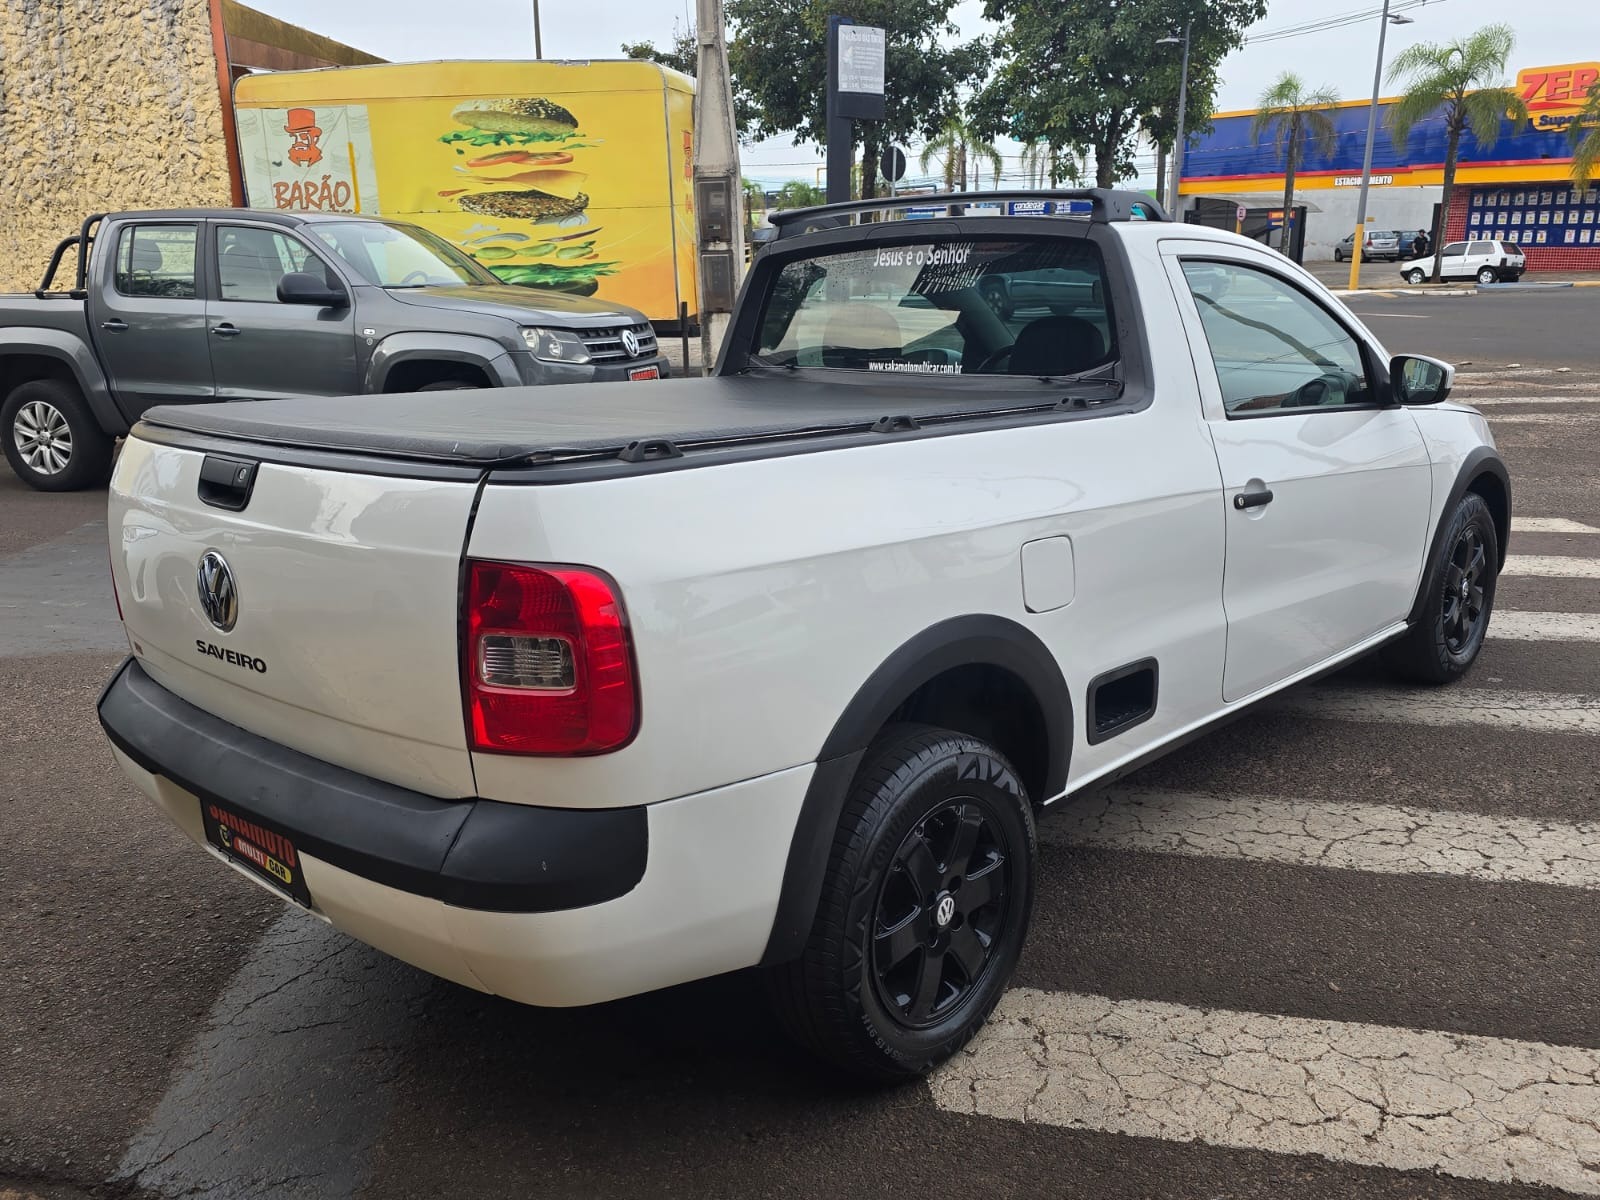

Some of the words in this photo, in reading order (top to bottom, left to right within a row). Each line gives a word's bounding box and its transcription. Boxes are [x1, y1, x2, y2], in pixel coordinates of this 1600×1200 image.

[273, 174, 351, 210] BARÃO
[874, 247, 903, 267] Jesus
[906, 245, 914, 266] é
[916, 250, 924, 266] o
[926, 243, 971, 265] Senhor
[196, 639, 267, 674] SAVEIRO
[269, 858, 287, 881] CAR
